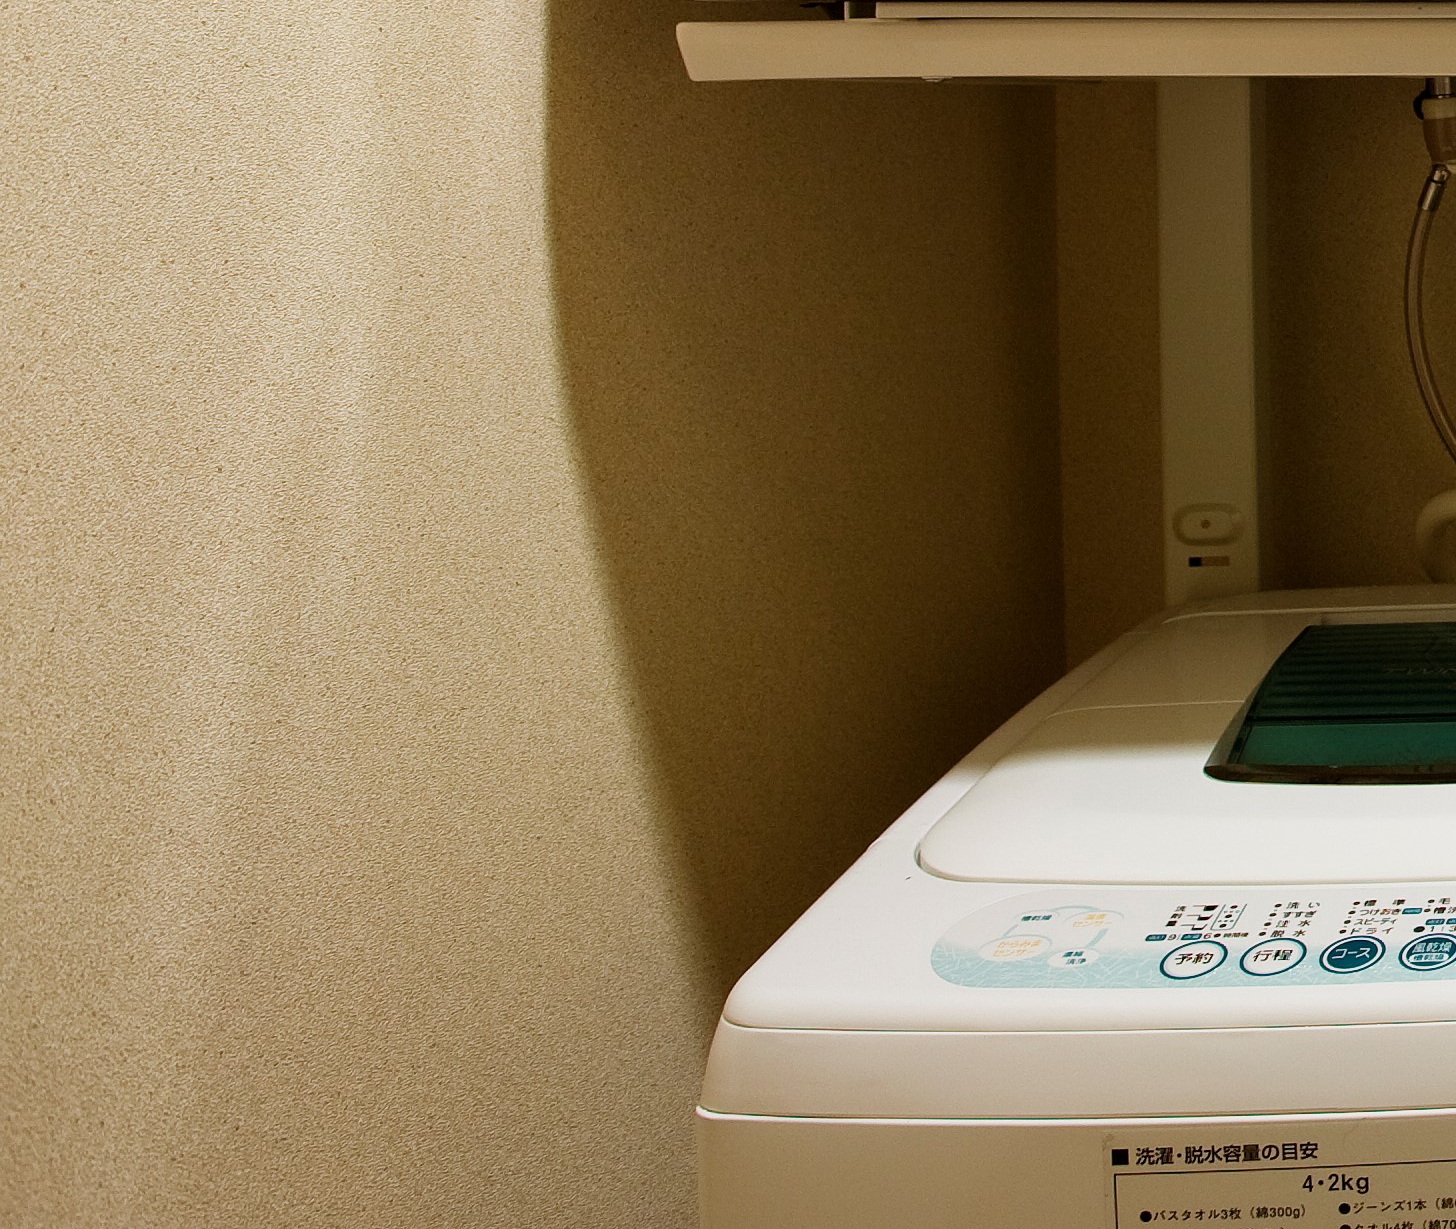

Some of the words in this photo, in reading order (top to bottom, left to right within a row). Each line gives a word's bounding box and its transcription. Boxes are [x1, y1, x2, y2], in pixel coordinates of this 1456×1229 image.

[1174, 953, 1213, 964] 予約
[1254, 950, 1294, 962] 行程
[1332, 948, 1370, 959] コース
[1136, 1142, 1319, 1165] 洗濯・脱水容量の目安
